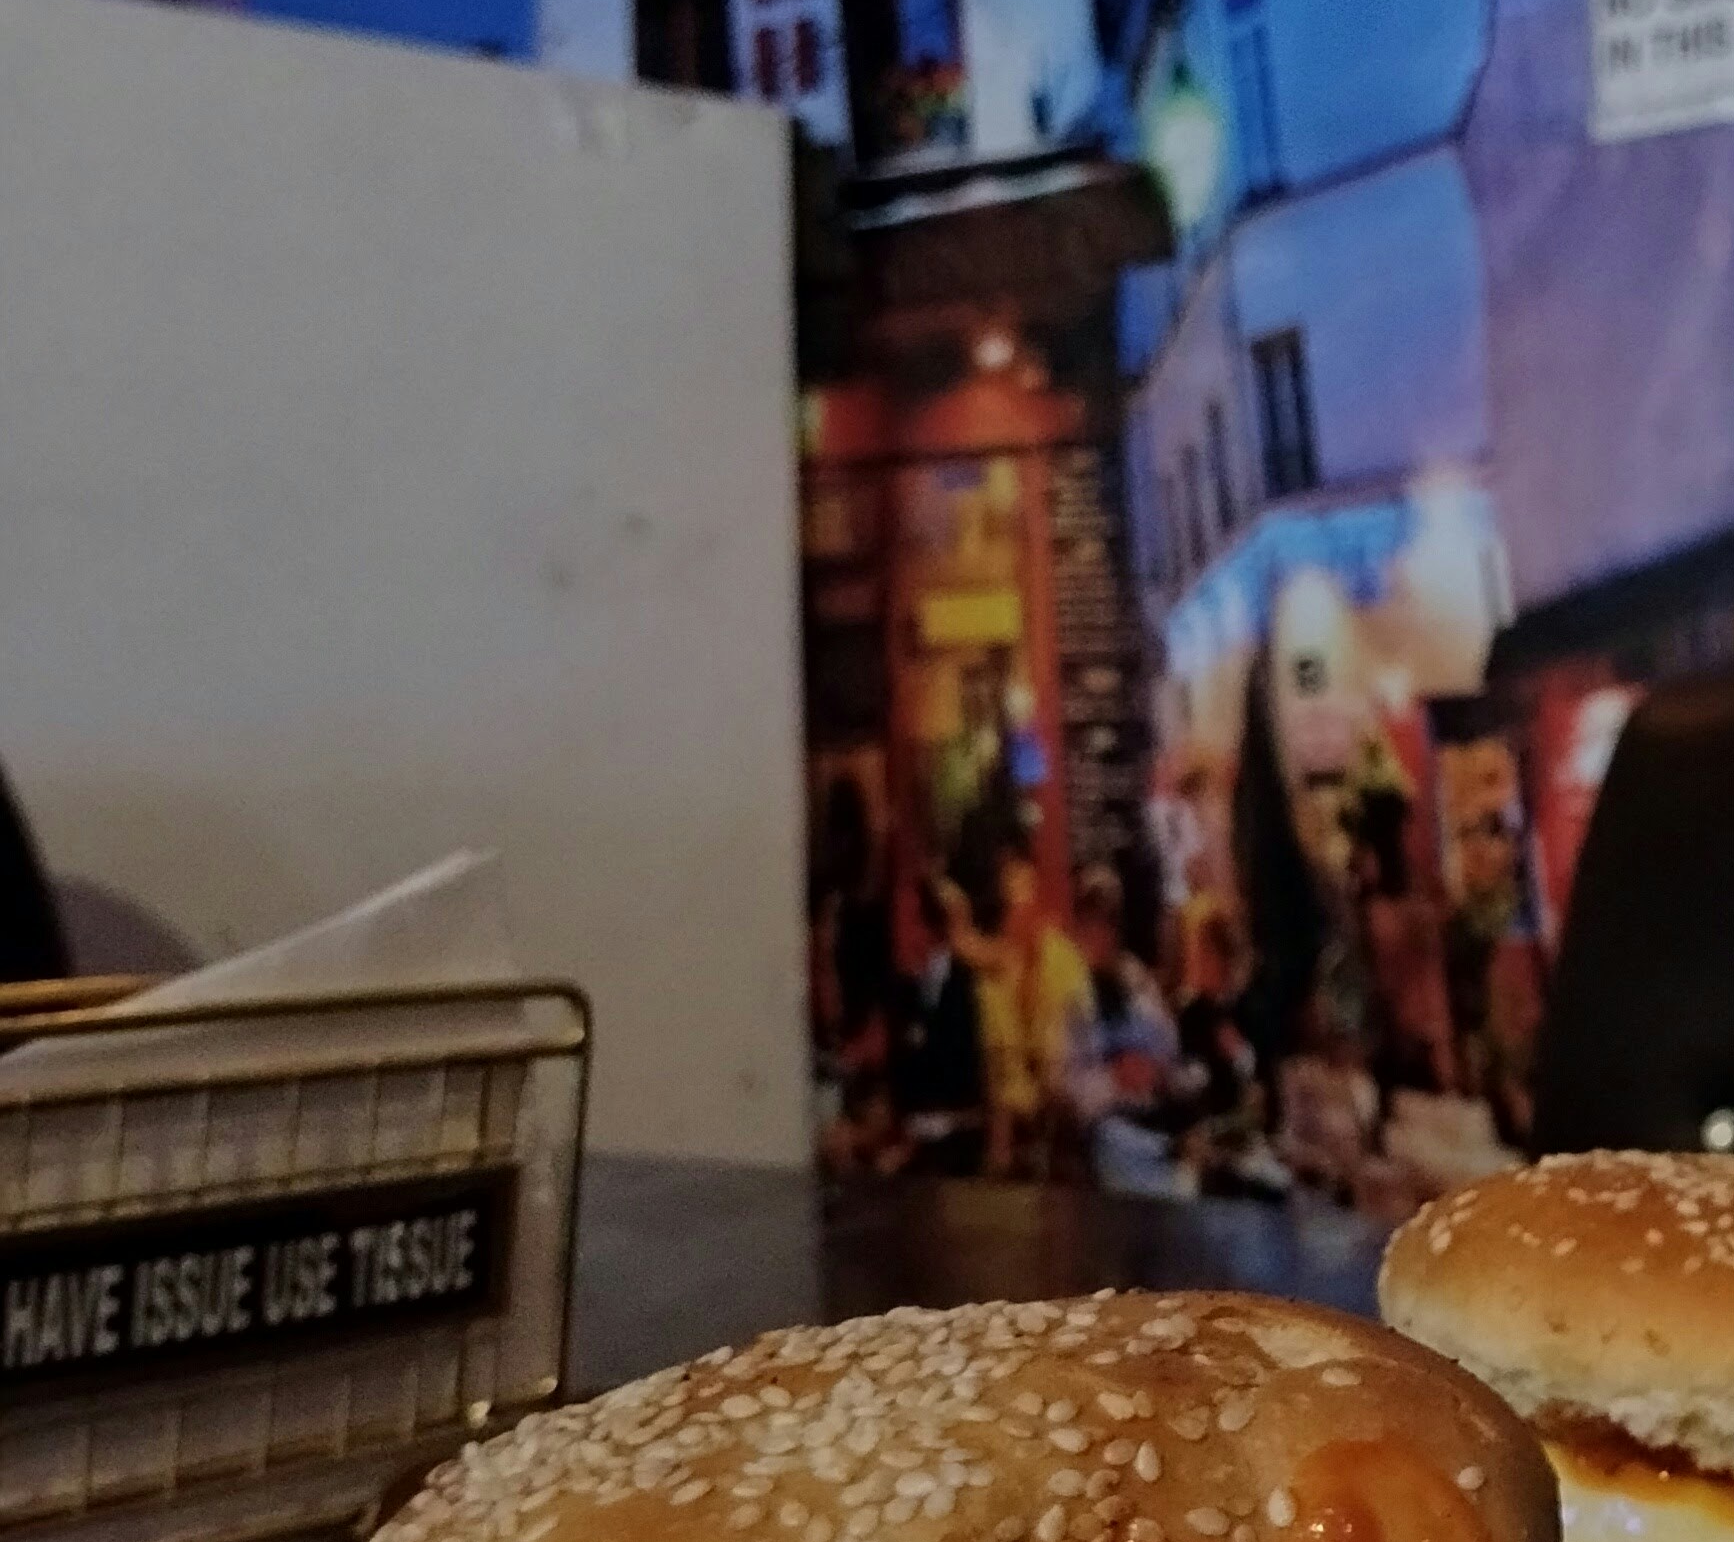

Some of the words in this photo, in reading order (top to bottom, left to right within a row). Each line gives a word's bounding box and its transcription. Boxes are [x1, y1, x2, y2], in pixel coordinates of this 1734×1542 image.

[1651, 20, 1730, 62] THIS
[3, 1262, 123, 1365] HAVE
[131, 1246, 254, 1348] ISSUE
[263, 1233, 338, 1326] USE
[350, 1209, 478, 1307] TISSUE
